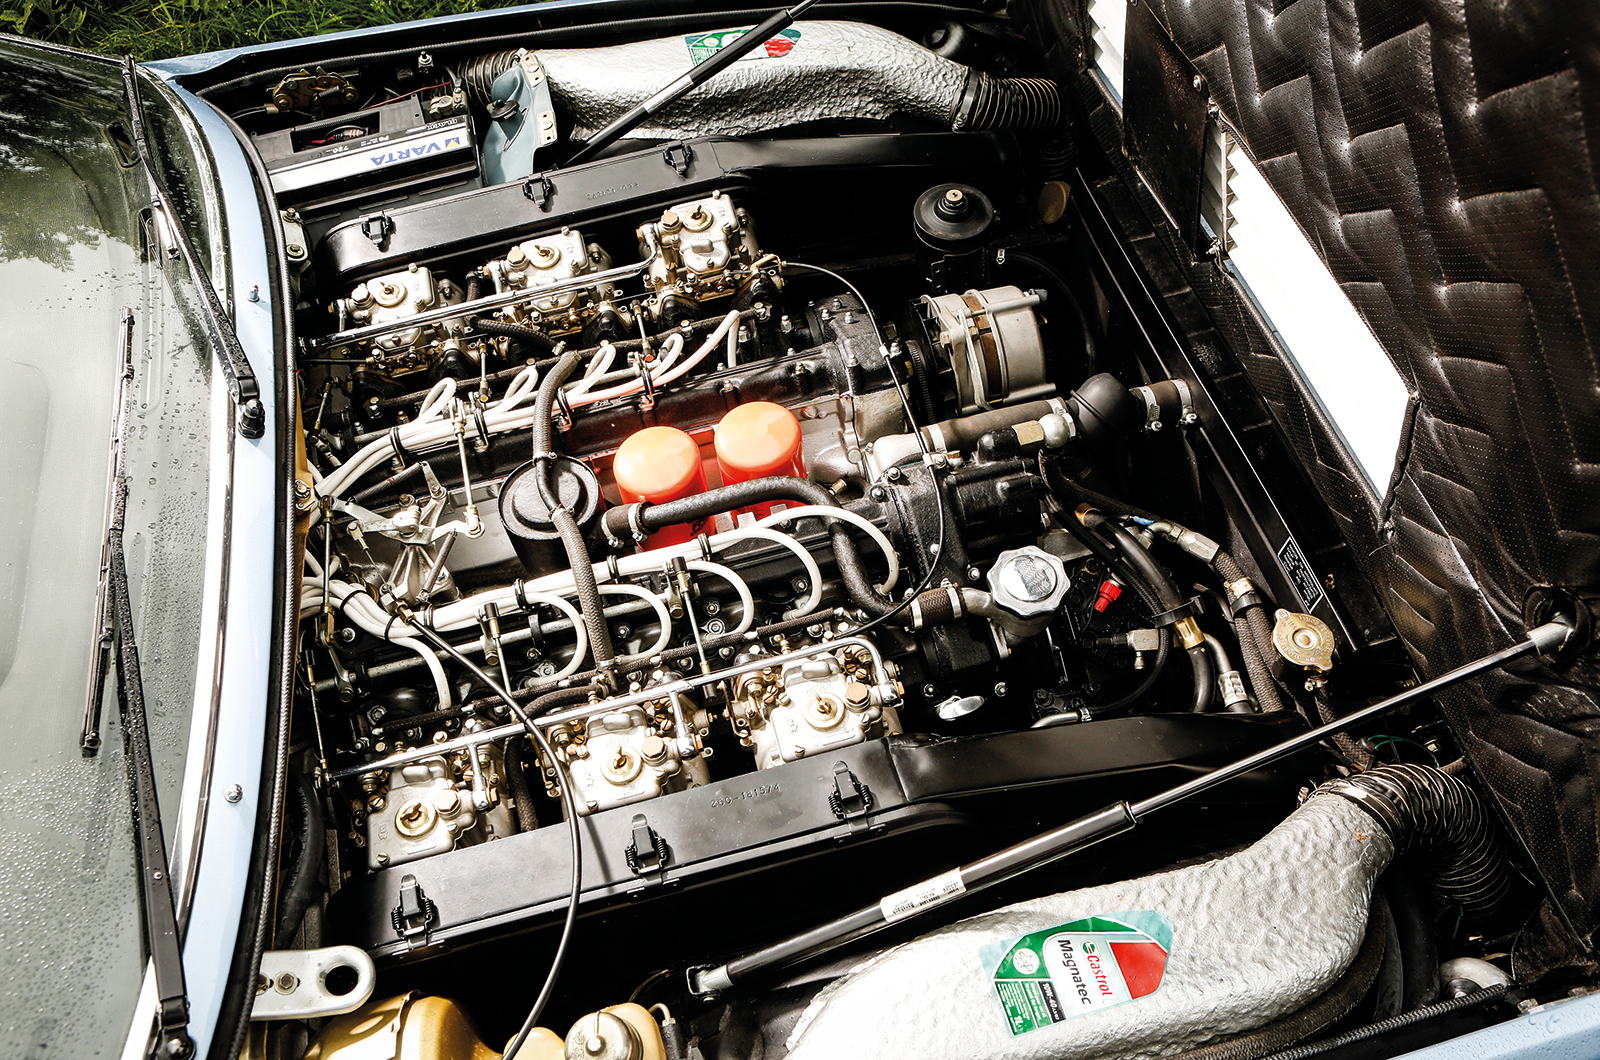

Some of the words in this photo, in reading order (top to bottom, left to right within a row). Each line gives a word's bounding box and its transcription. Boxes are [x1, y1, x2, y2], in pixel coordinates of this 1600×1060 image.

[332, 144, 350, 154] 720
[370, 142, 441, 166] VARTA
[1057, 939, 1092, 1005] Magnatec
[1087, 955, 1114, 997] Castrol
[1042, 982, 1057, 1007] 10W-40
